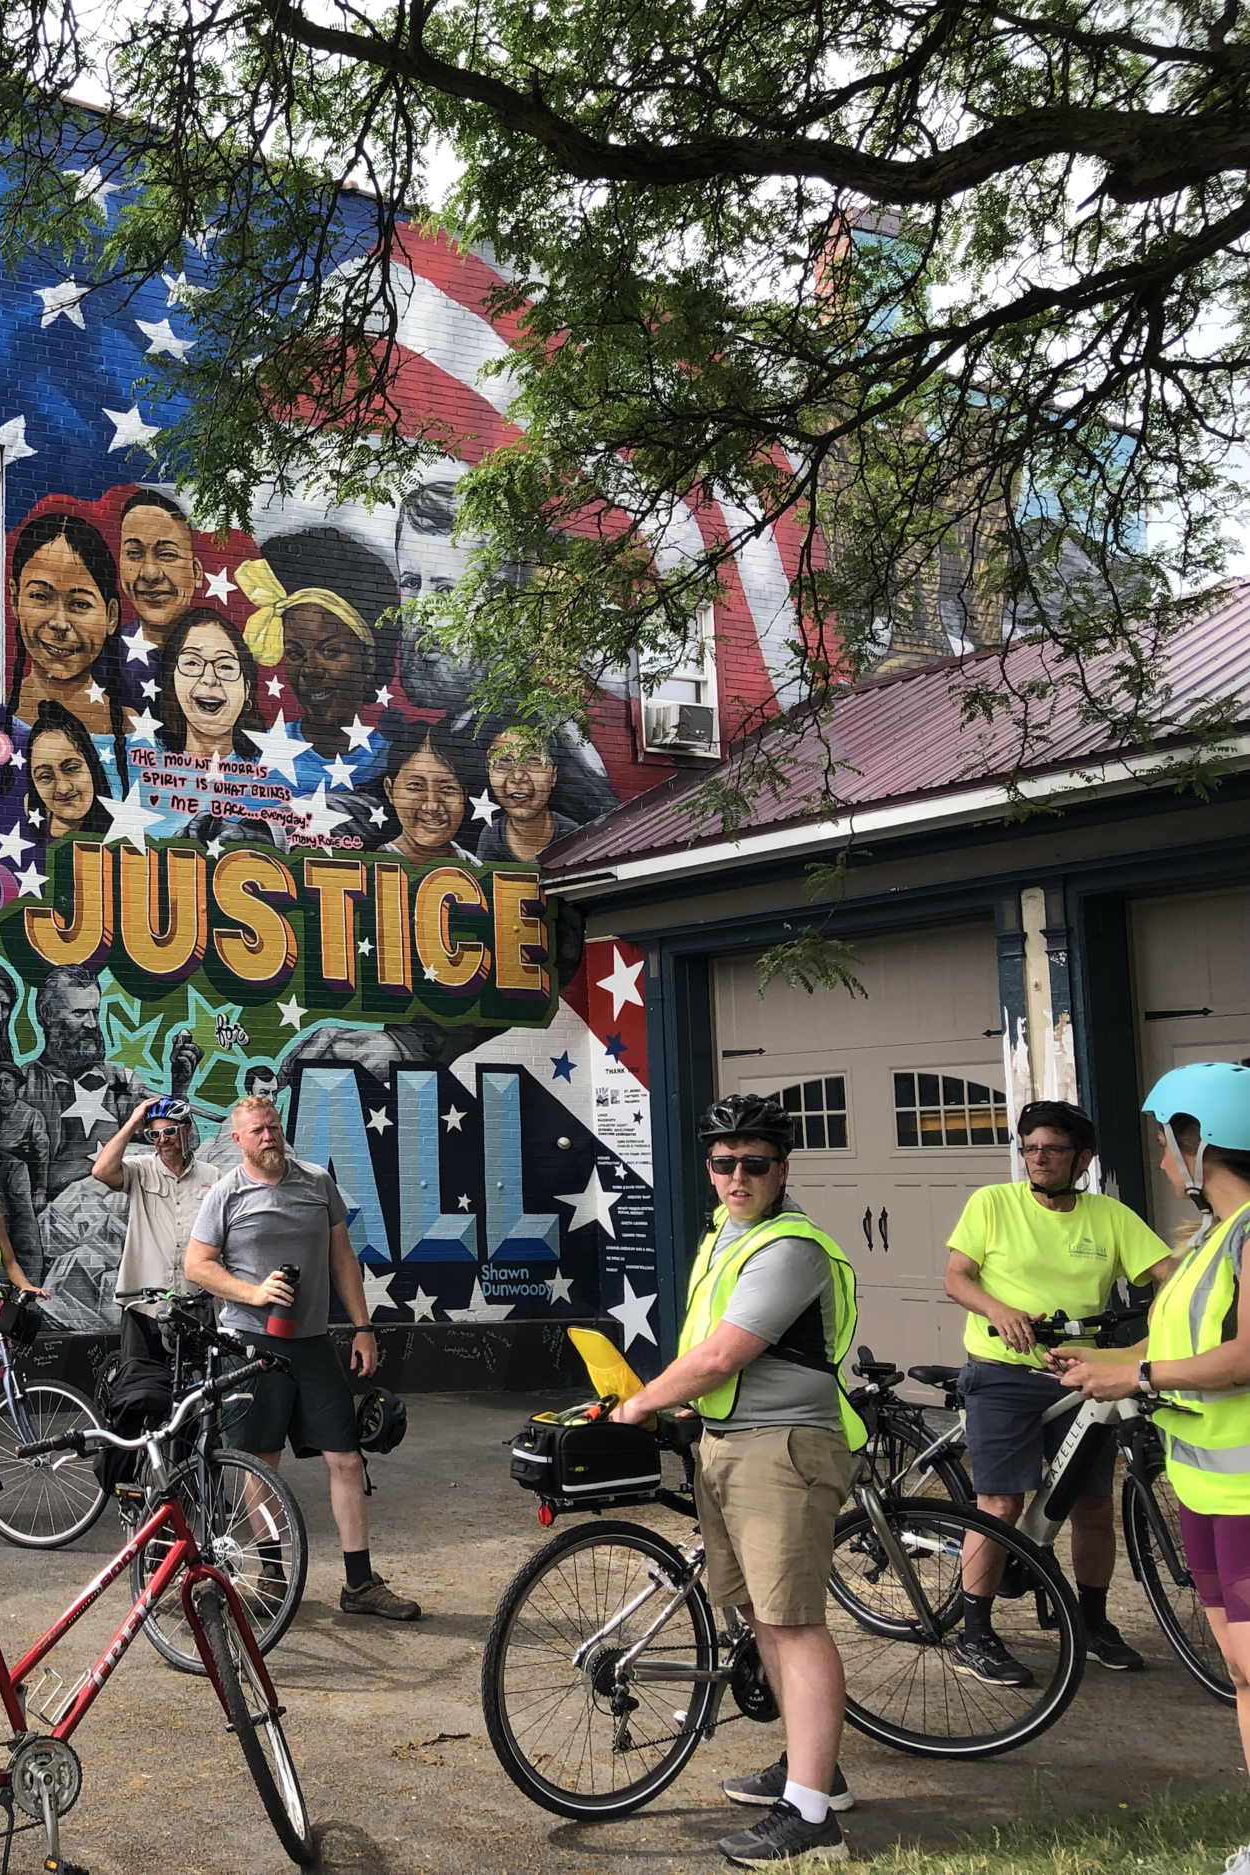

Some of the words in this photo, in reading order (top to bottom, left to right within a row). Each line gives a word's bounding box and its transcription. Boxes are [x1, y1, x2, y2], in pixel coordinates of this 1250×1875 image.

[132, 749, 157, 767] THE
[219, 761, 268, 779] MORRIS
[142, 772, 187, 788] SPIRIT
[196, 777, 209, 790] IS
[213, 782, 248, 797] WHAT
[251, 783, 291, 802] BRINGS
[170, 797, 199, 813] ME
[24, 840, 549, 995] JUSTICE
[293, 1067, 561, 1264] ALL
[481, 1264, 529, 1281] Shawn
[1044, 1418, 1084, 1490] GAZELLE
[88, 1588, 158, 1688] TREK
